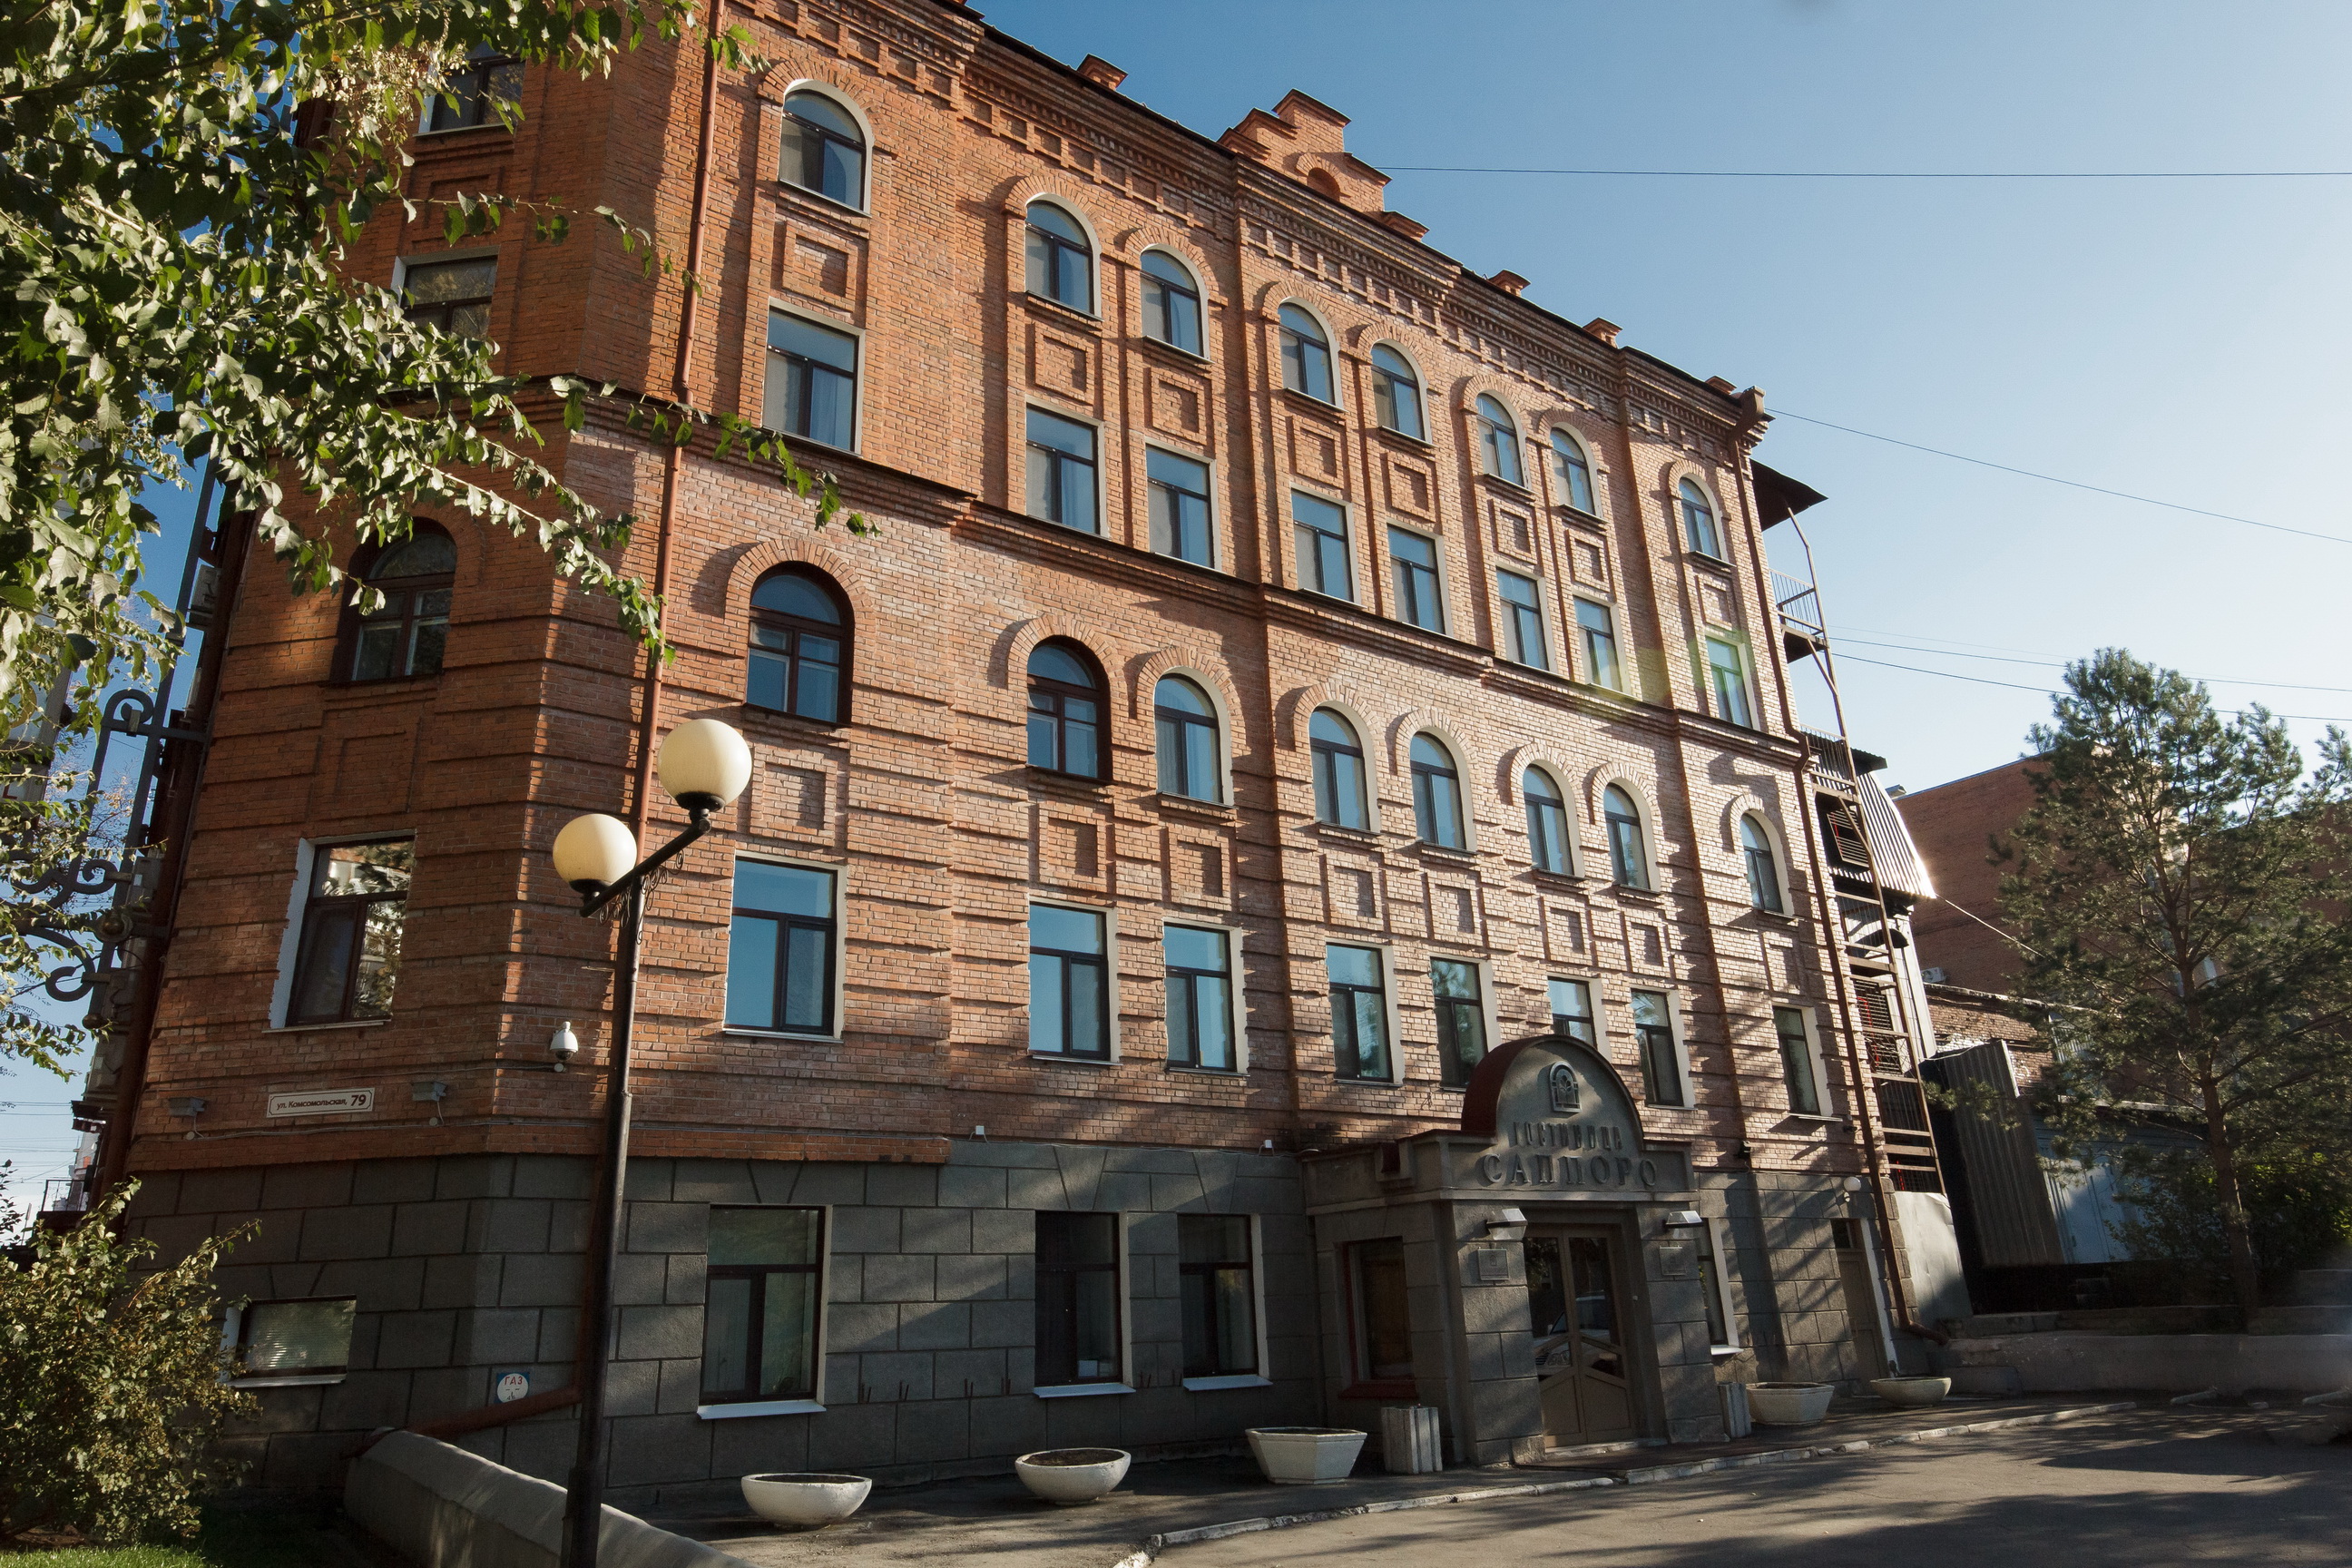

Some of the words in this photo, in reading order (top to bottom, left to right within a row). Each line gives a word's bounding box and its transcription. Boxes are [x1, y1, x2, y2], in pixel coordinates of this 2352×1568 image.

[289, 1098, 347, 1108] Комсомольская,
[350, 1094, 367, 1106] 79
[1514, 1122, 1622, 1149] ГОСТИНИЦА
[1484, 1153, 1656, 1186] САППОРО
[505, 1376, 524, 1385] ГАЗ
